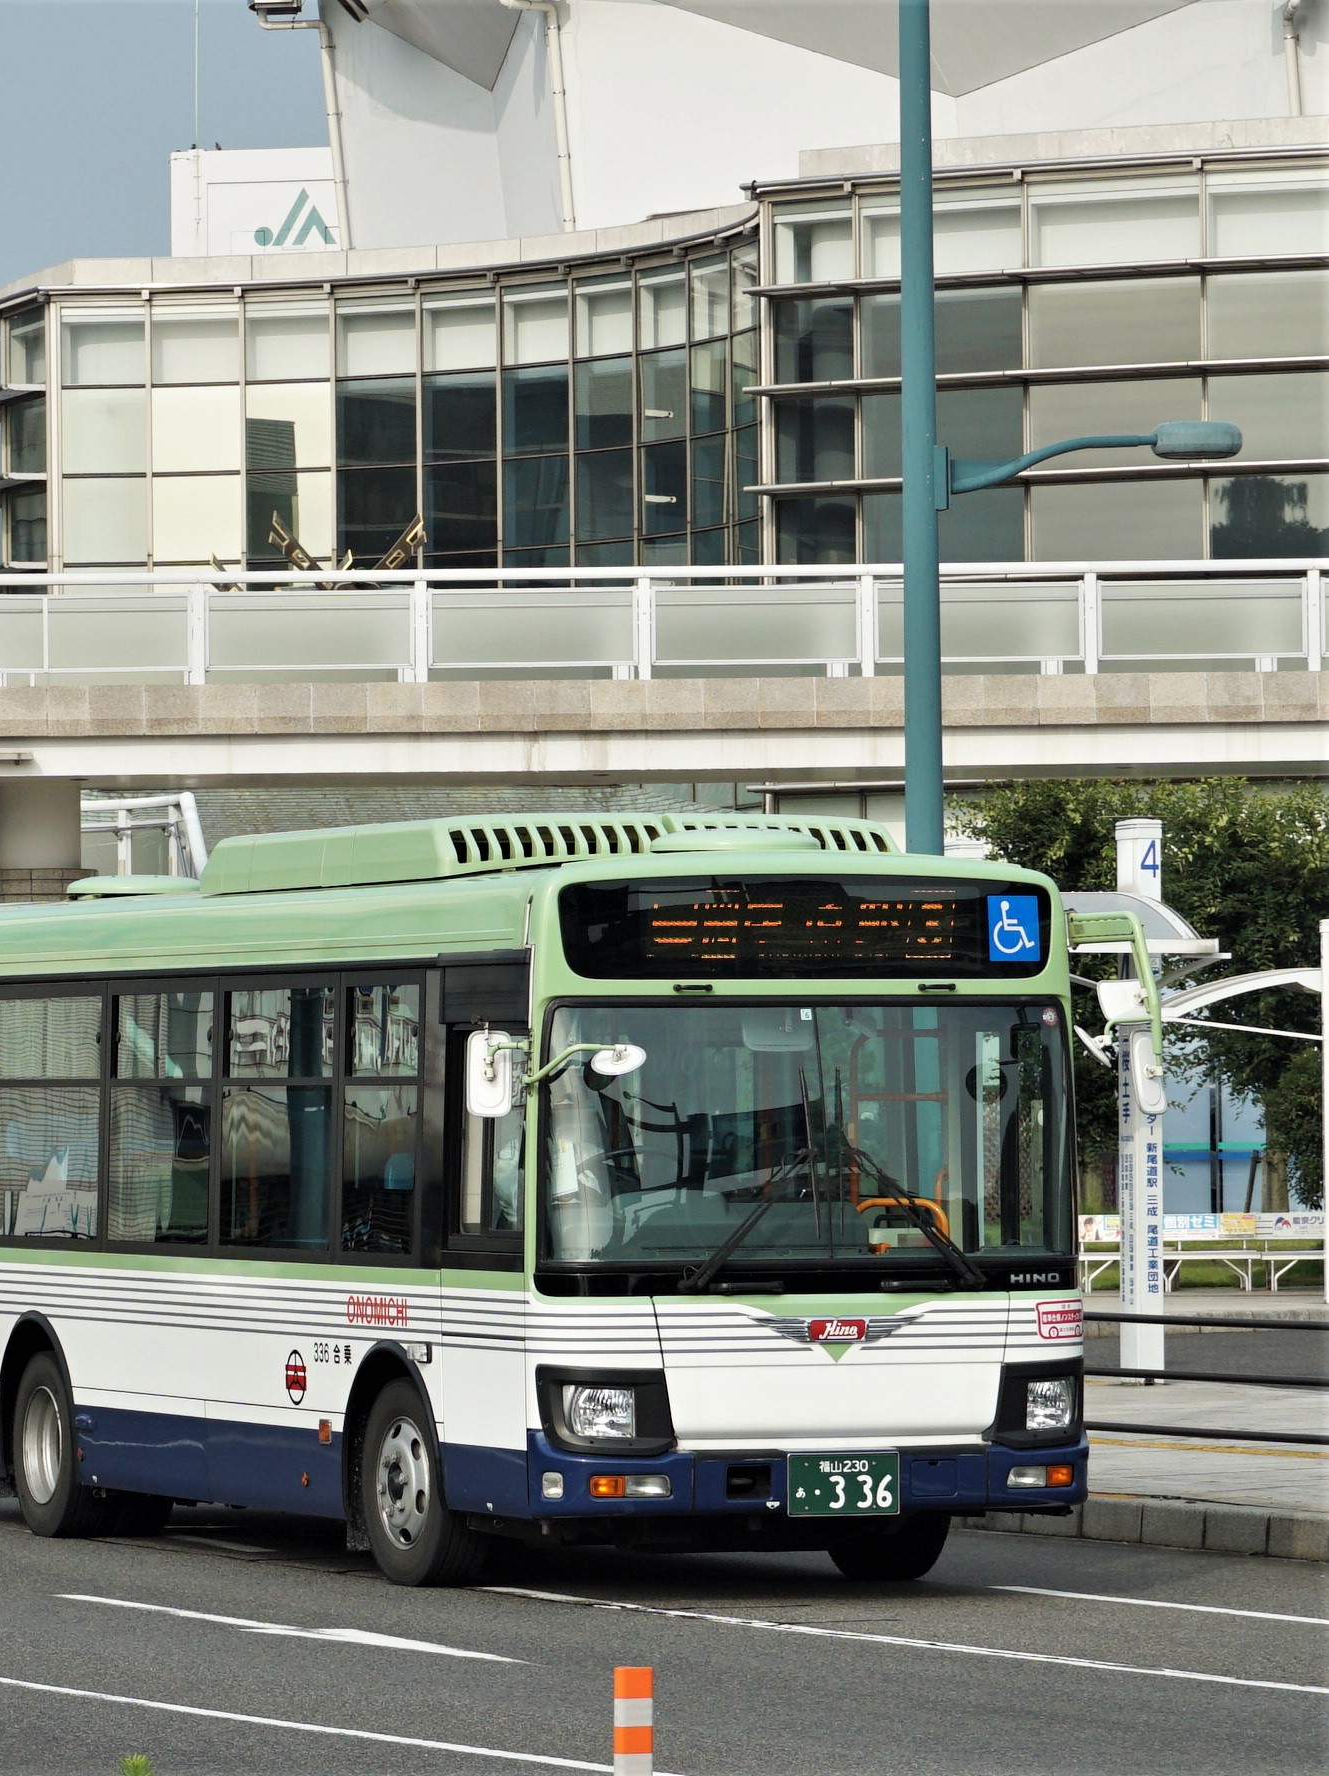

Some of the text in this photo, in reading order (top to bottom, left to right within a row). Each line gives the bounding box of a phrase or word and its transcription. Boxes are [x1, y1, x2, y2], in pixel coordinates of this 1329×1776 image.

[1140, 839, 1160, 878] 4
[1146, 1142, 1158, 1188] 新尾道駅
[1146, 1194, 1159, 1217] 三成
[1163, 1214, 1216, 1230] 個別ゼミ
[1147, 1224, 1160, 1294] 尾道工業団地
[1010, 1272, 1061, 1284] HINO
[347, 1295, 408, 1327] ONOMICHI
[819, 1321, 859, 1340] Hino
[313, 1342, 330, 1363] 336
[795, 1486, 806, 1498] あ
